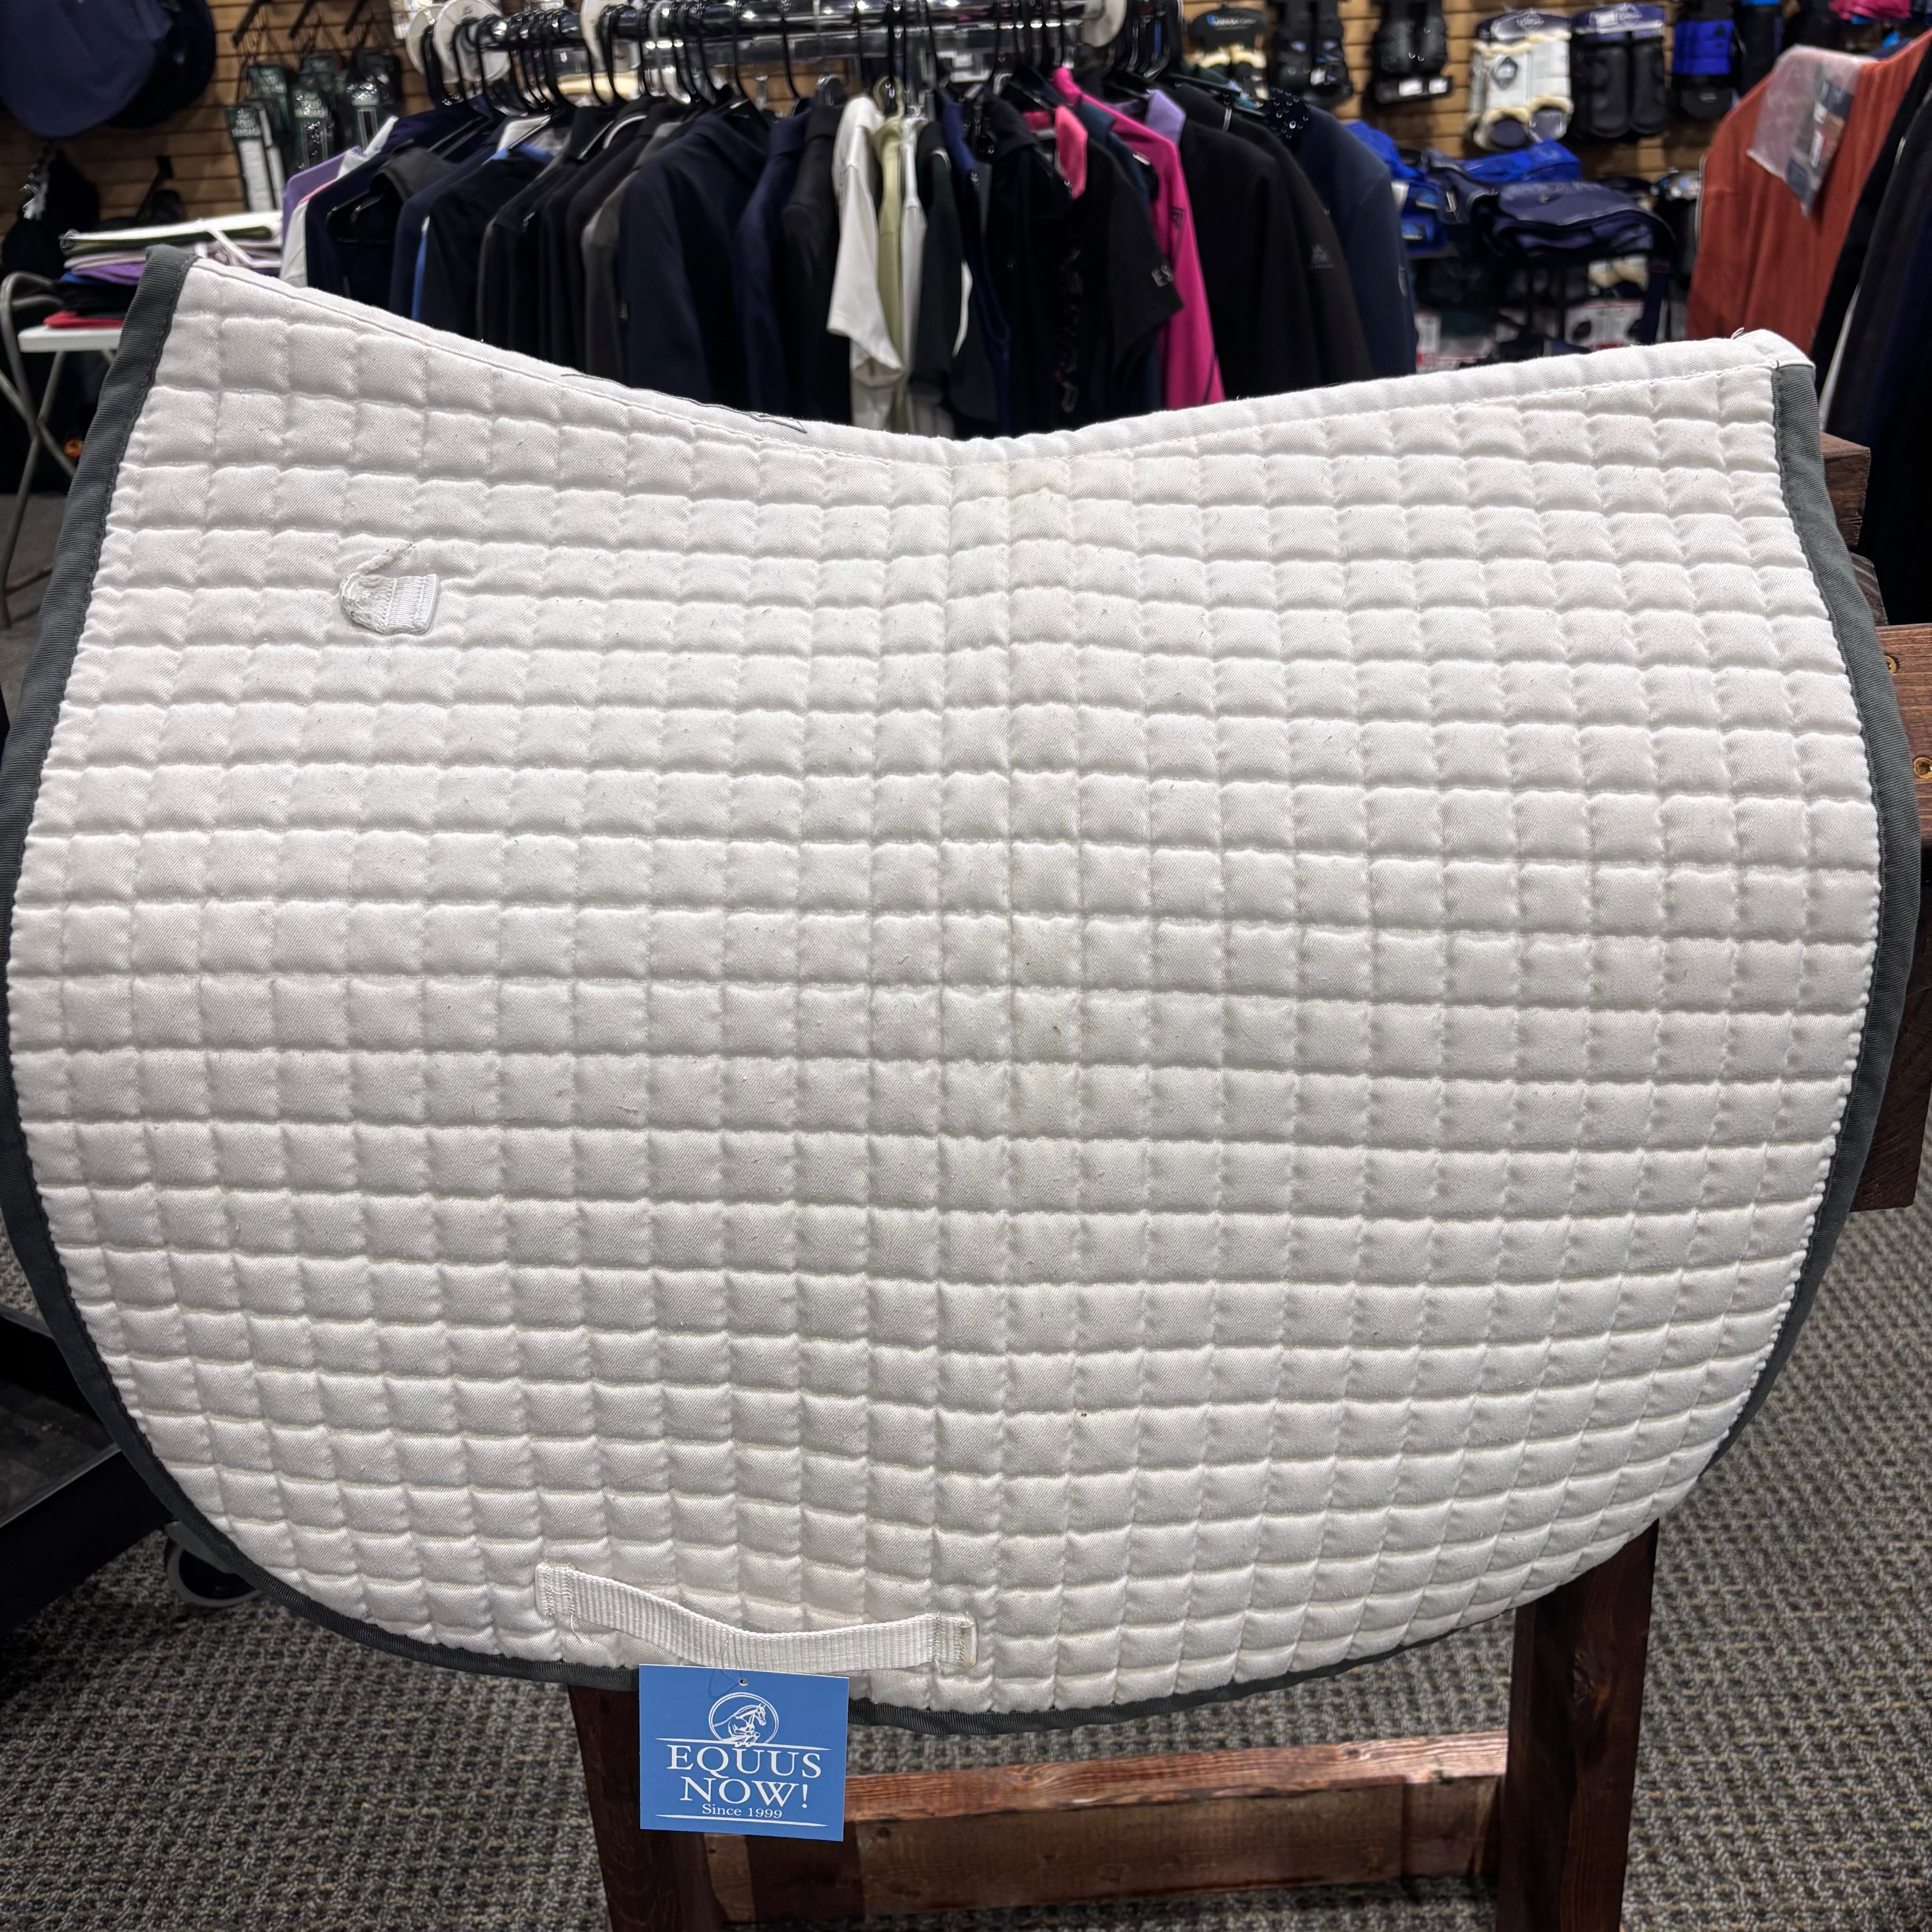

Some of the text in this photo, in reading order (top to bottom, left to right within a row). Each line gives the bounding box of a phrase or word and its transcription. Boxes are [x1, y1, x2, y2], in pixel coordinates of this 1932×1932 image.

[667, 1744, 822, 1779] EQUUS
[680, 1776, 808, 1809] NOW!
[702, 1803, 782, 1819] Since 1999
